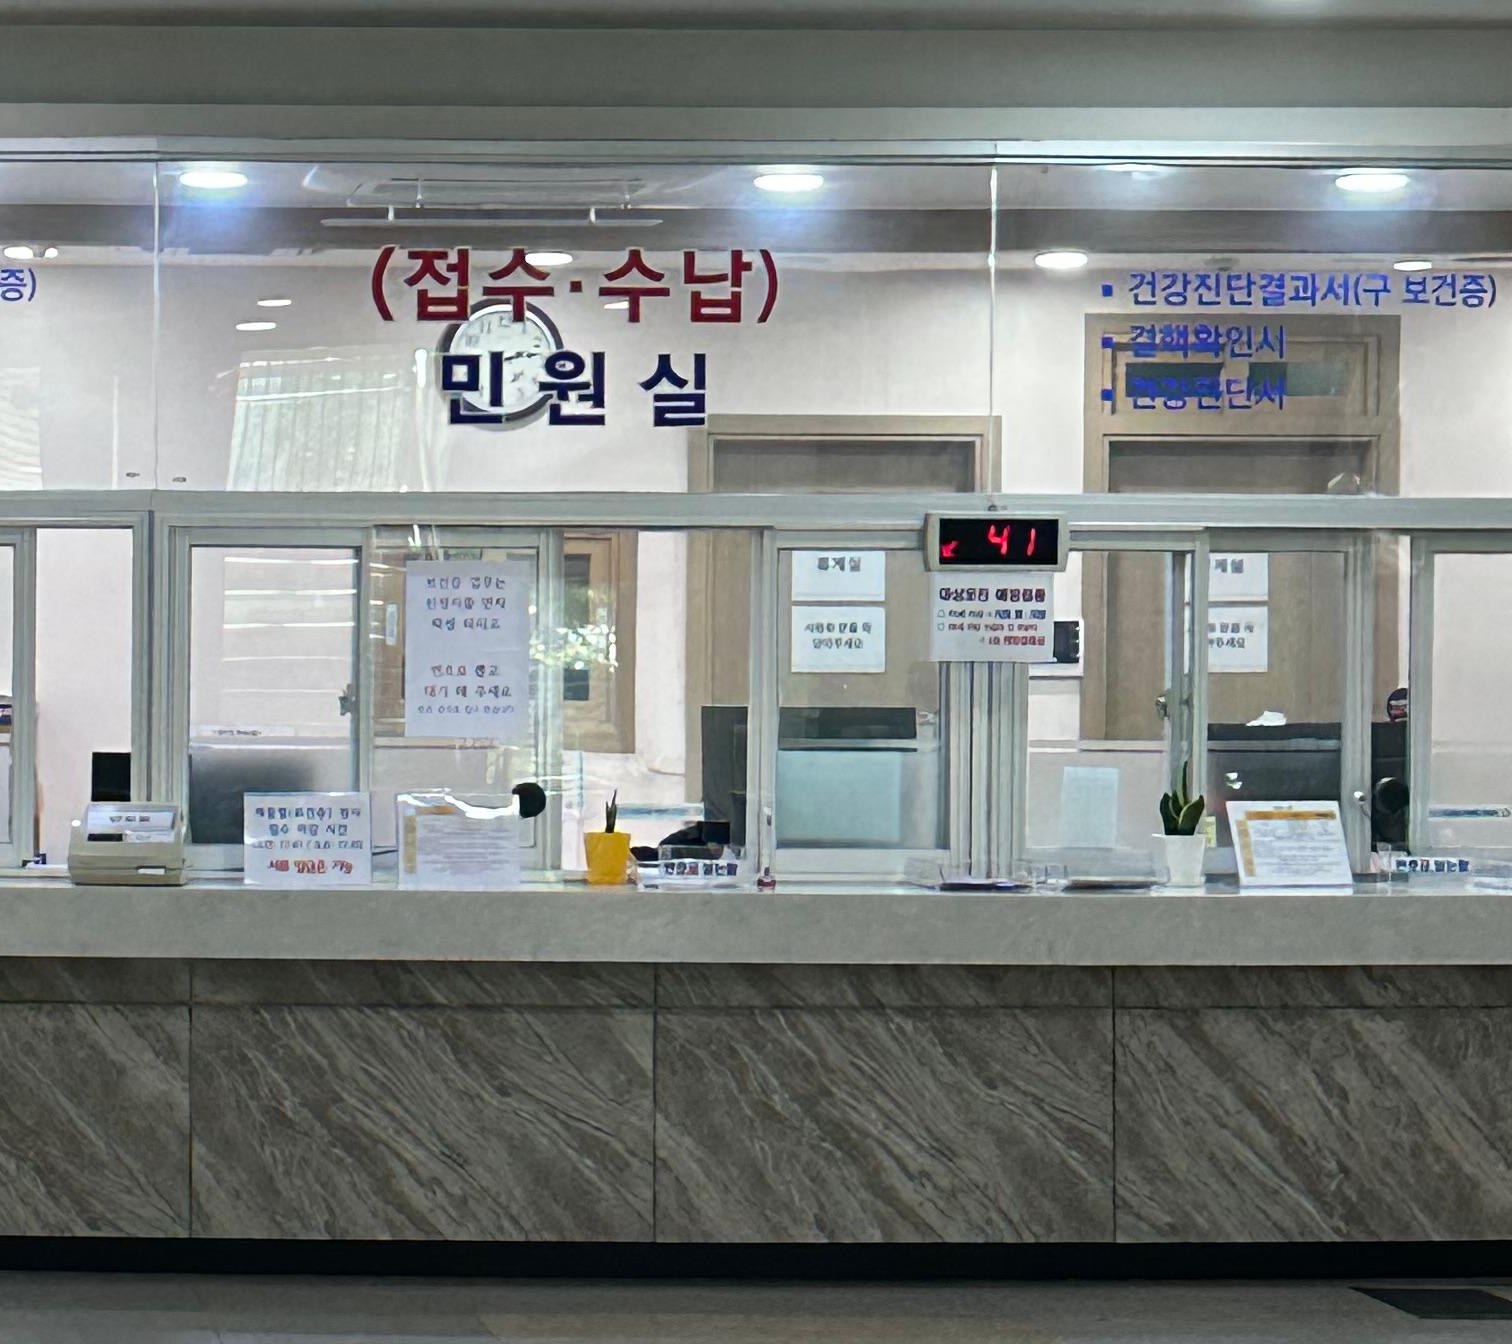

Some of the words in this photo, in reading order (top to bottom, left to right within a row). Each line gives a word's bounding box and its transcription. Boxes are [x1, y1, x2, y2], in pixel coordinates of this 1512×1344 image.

[371, 246, 779, 324] (접수·수납)
[1128, 270, 1392, 307] 건강진단결과서(구
[1401, 272, 1497, 308] 보건증)
[1129, 323, 1286, 359] 결핵확인서
[1129, 375, 1286, 411] 건강진단서
